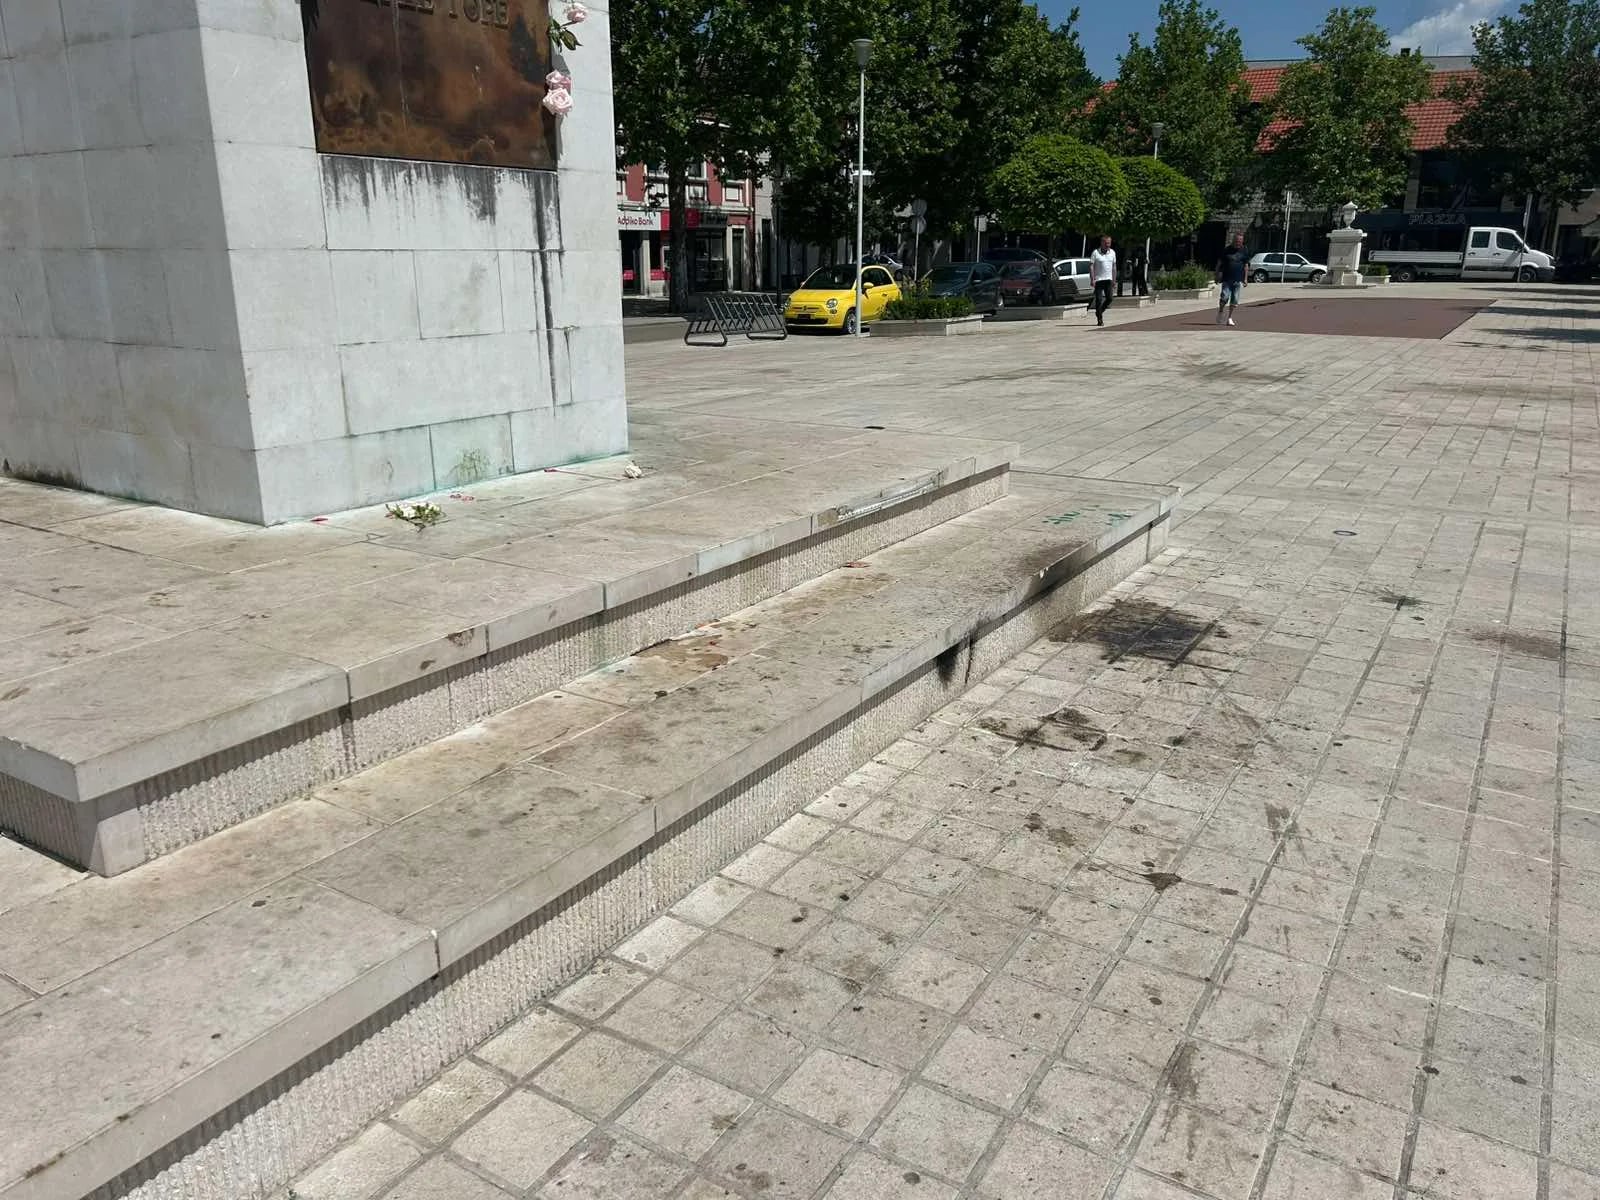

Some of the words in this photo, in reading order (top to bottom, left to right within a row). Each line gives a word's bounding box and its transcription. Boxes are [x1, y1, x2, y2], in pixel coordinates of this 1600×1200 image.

[617, 215, 638, 225] Addiko
[638, 216, 654, 226] Bank
[1408, 213, 1465, 225] PIAZZA
